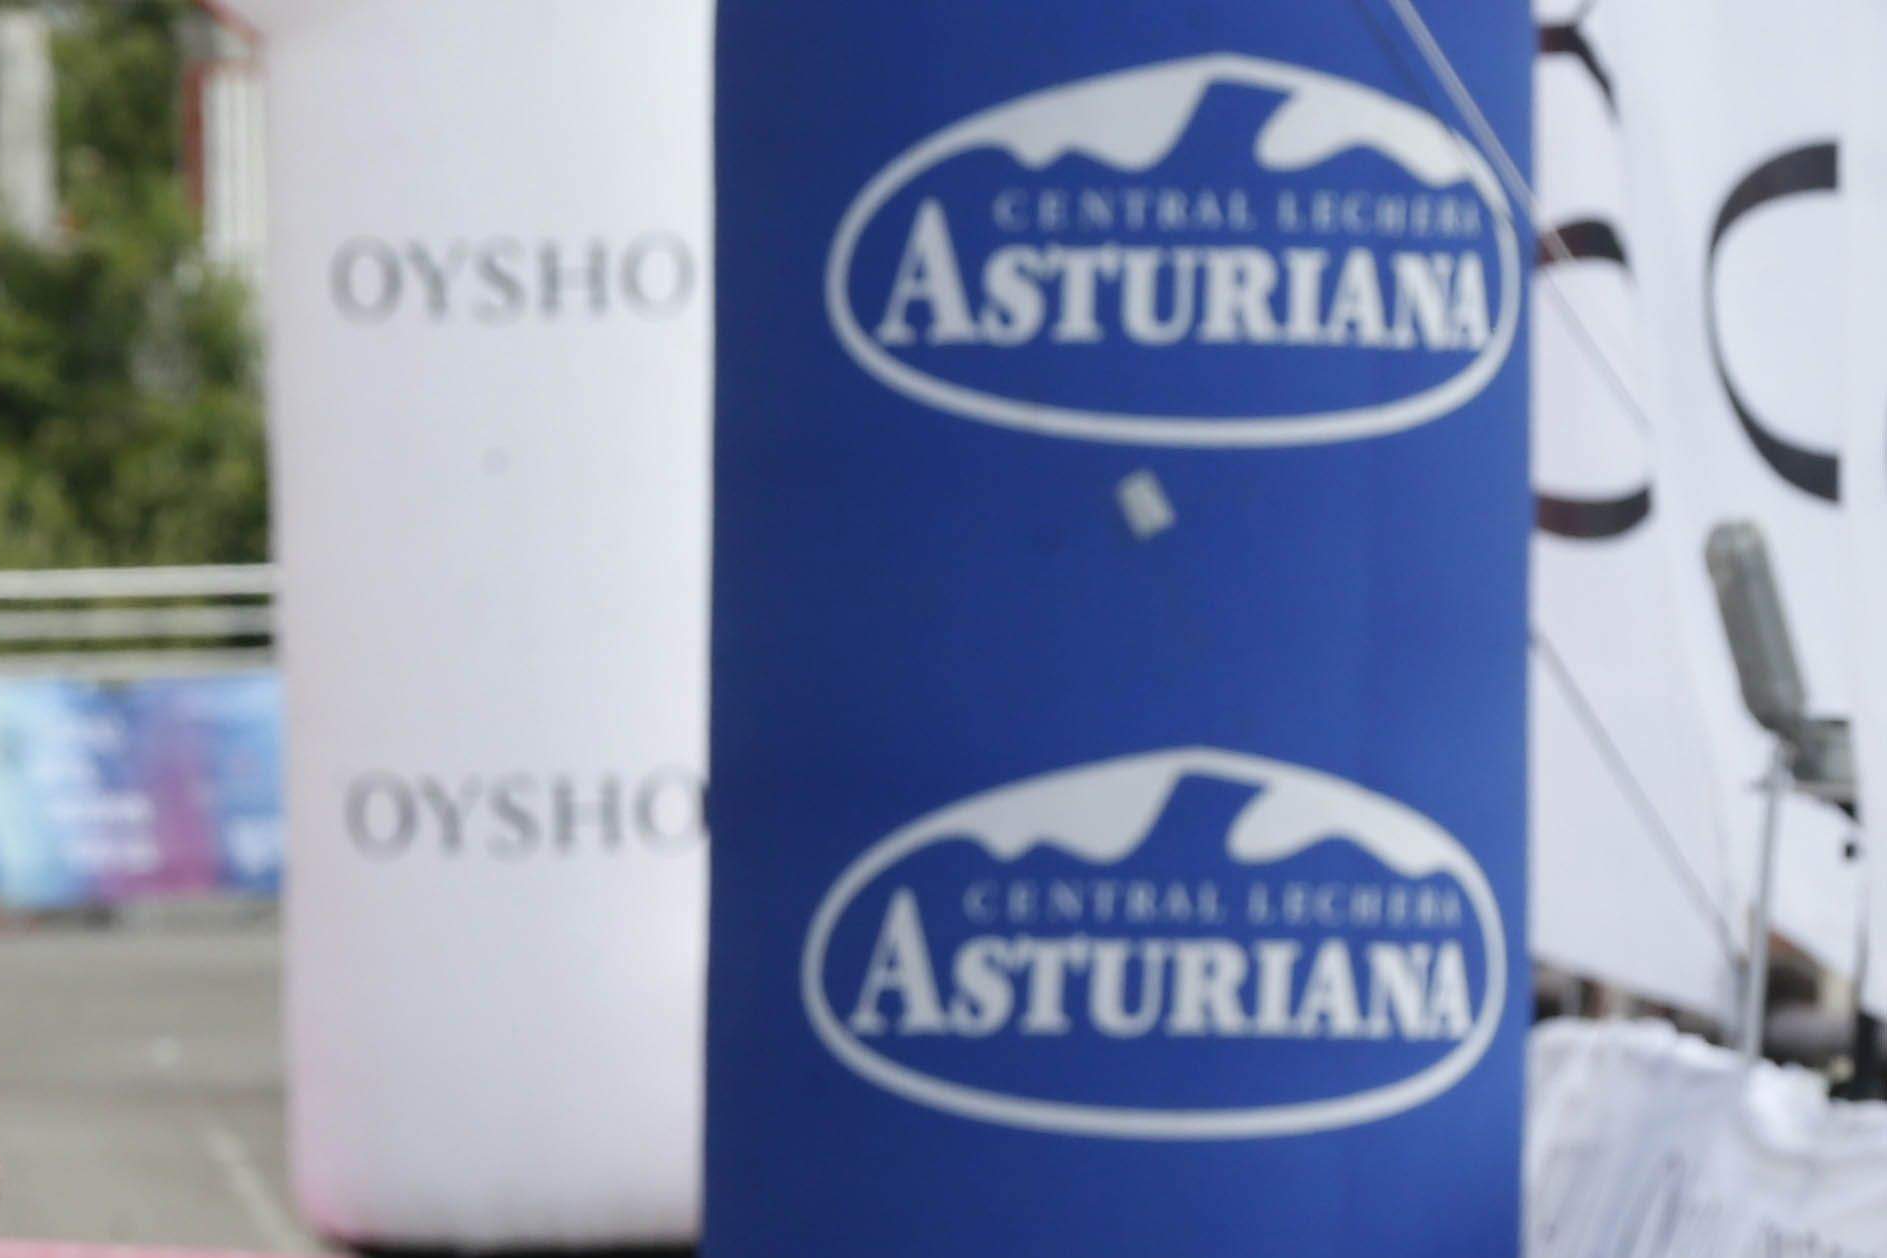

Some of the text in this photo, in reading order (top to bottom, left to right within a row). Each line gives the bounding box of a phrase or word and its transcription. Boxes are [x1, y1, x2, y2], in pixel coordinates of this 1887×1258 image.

[994, 186, 1254, 232] CENTRAL
[329, 232, 697, 325] OYSHO
[876, 198, 1488, 350] ASTURIANA
[344, 767, 708, 861] OYSHO
[964, 880, 1225, 924] CENTRAL
[848, 886, 1472, 1040] ASTURIANA
